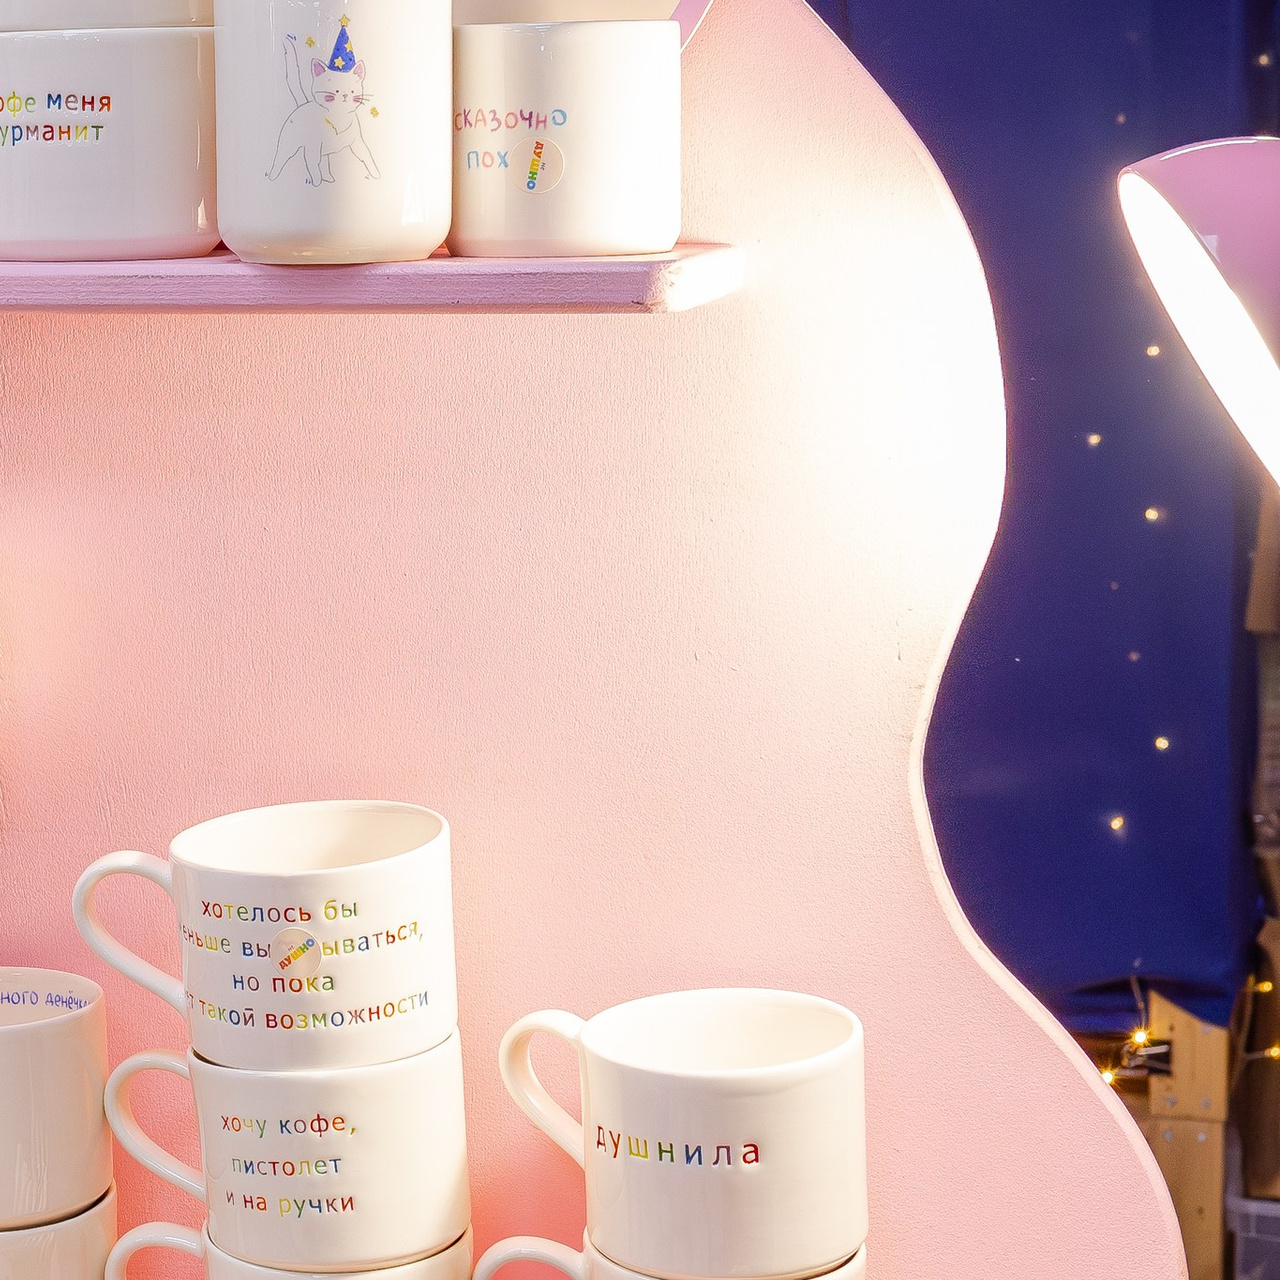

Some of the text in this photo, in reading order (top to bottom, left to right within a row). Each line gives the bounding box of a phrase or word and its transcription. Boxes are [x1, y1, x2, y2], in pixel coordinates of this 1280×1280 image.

[47, 92, 112, 113] меня
[454, 108, 567, 132] СКАЗОЧНО
[467, 150, 509, 169] ПОХ
[526, 140, 544, 190] ДУШНО
[201, 899, 358, 923] хотелось бы
[182, 925, 231, 954] еньше
[278, 938, 315, 970] ДУШНО
[233, 974, 334, 993] но пока
[198, 999, 255, 1027] такой
[266, 990, 429, 1031] возможности
[221, 1113, 357, 1139] хочу кофе,
[596, 1125, 760, 1166] душнила
[231, 1155, 342, 1178] пистолет
[226, 1189, 355, 1219] и на ручки
